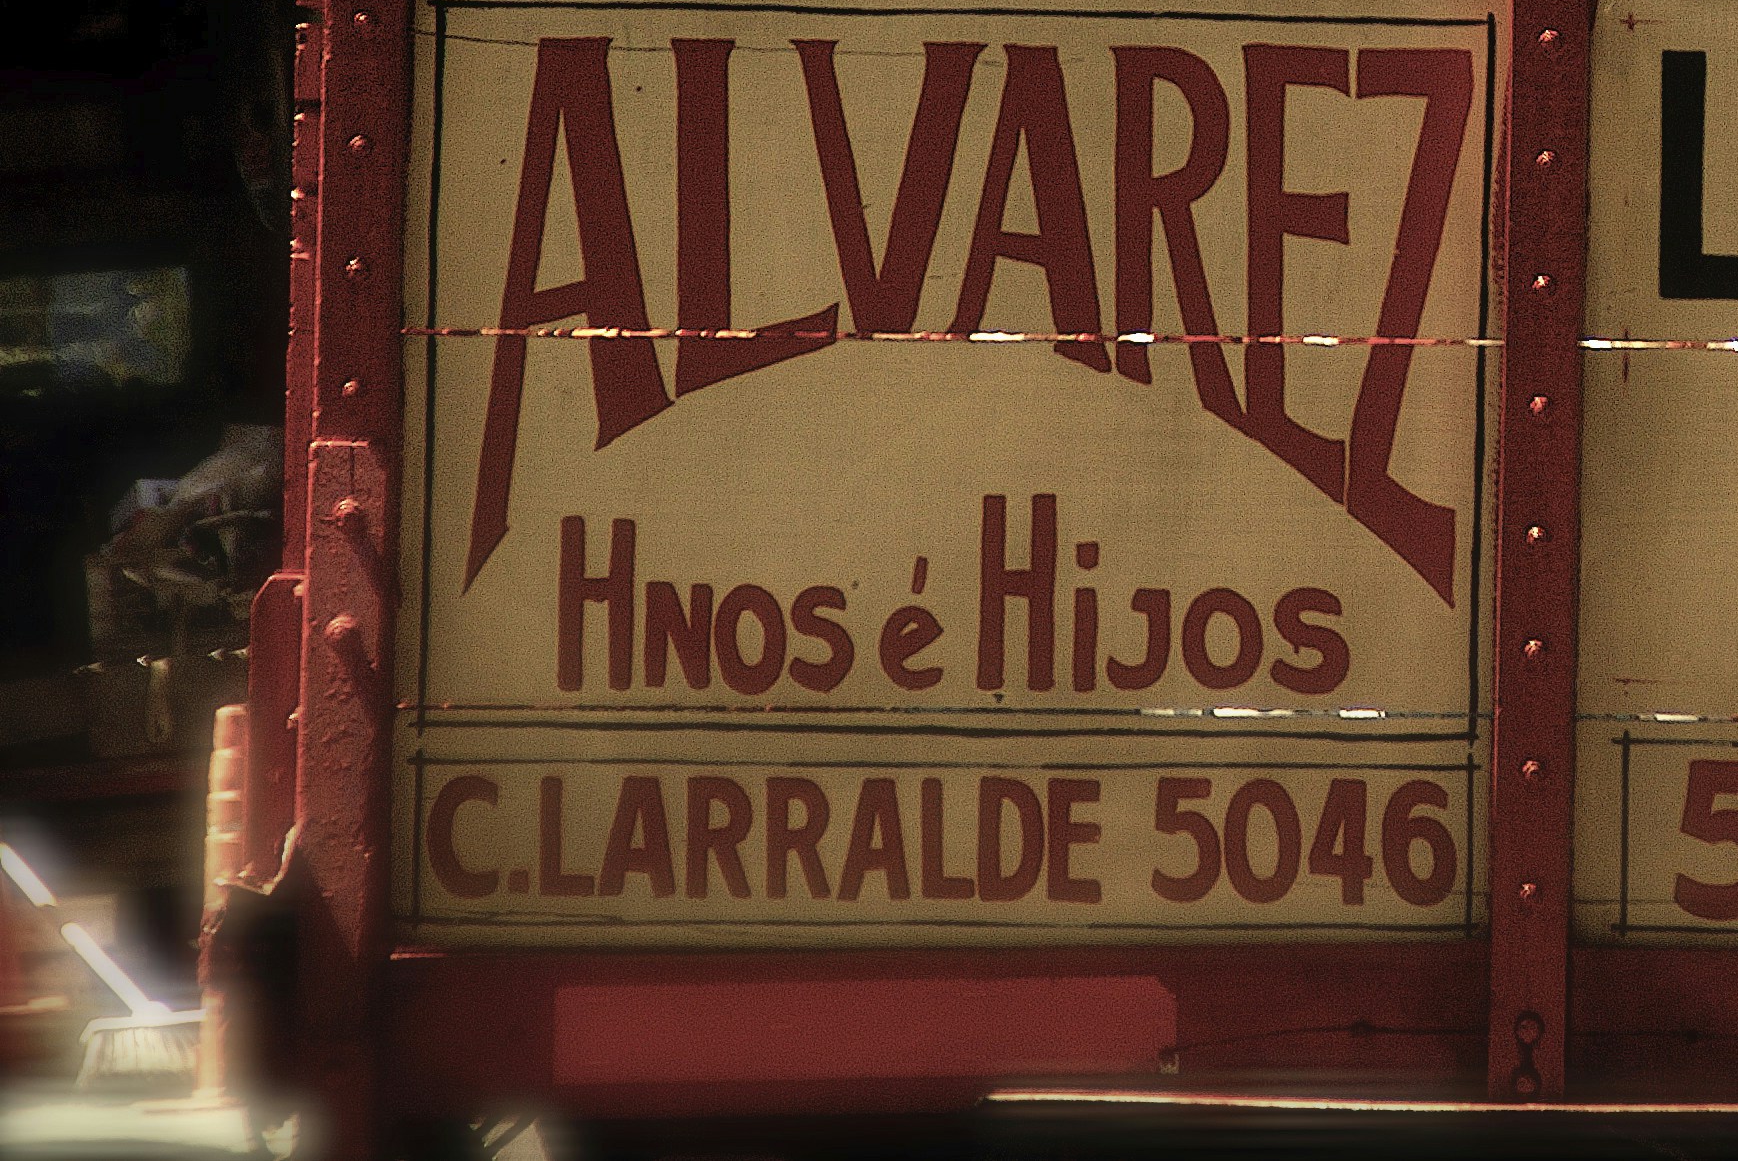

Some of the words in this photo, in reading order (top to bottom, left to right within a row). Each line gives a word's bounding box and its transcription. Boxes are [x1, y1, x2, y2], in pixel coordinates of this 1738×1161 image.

[463, 36, 1474, 609] ALVAREZ
[426, 774, 1103, 905] C.LARRALDE
[1151, 776, 1458, 905] 5046
